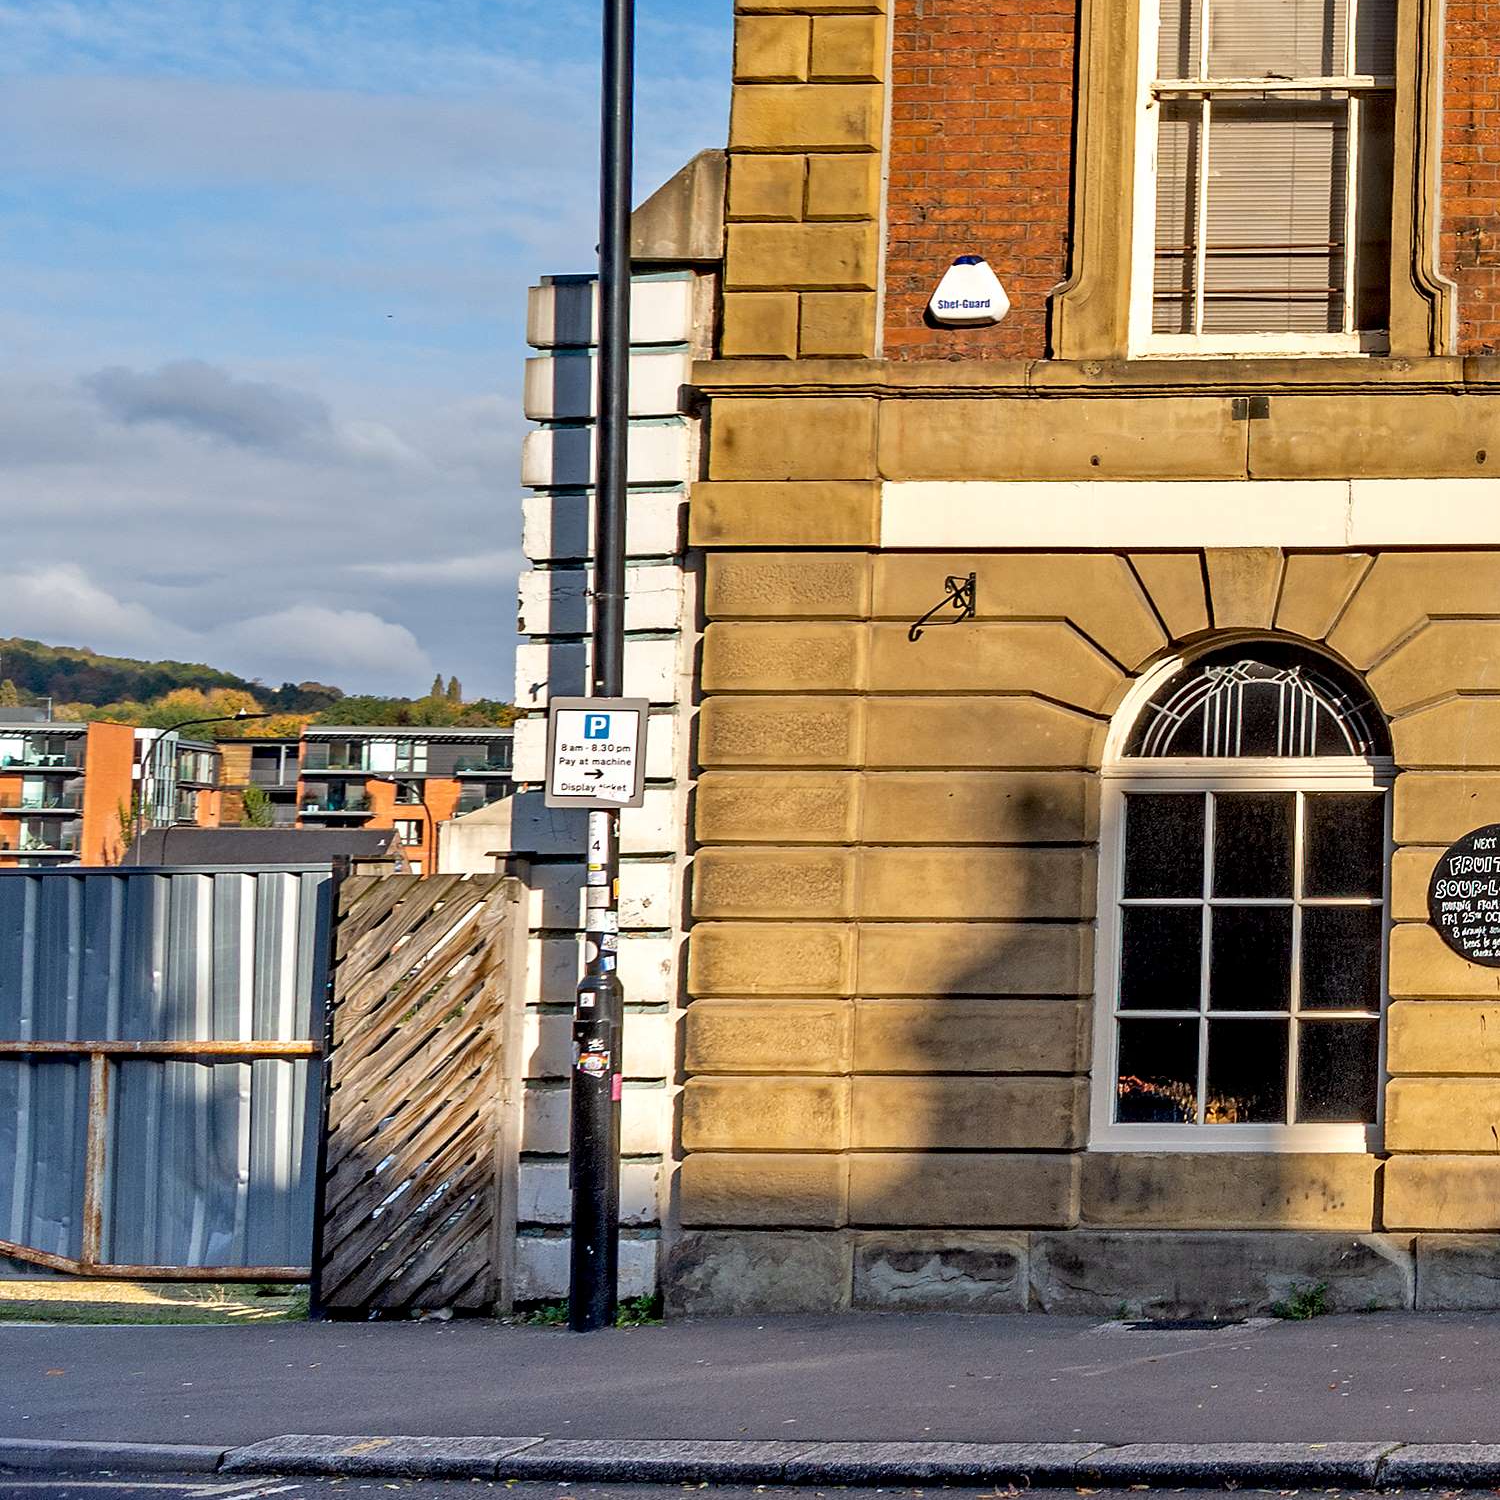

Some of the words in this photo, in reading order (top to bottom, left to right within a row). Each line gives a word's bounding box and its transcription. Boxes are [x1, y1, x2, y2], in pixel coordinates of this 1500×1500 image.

[937, 299, 991, 309] Shef-Guard
[590, 716, 607, 737] P
[561, 744, 567, 752] 8
[591, 744, 615, 752] 8.30
[616, 745, 631, 753] pm
[559, 756, 576, 766] Pay
[592, 757, 632, 766] machine
[560, 783, 596, 792] Display
[592, 840, 601, 851] 4
[1473, 838, 1496, 850] NEXT
[1477, 900, 1499, 911] FROM
[1442, 912, 1457, 925] FRI
[1452, 927, 1461, 938] 8
